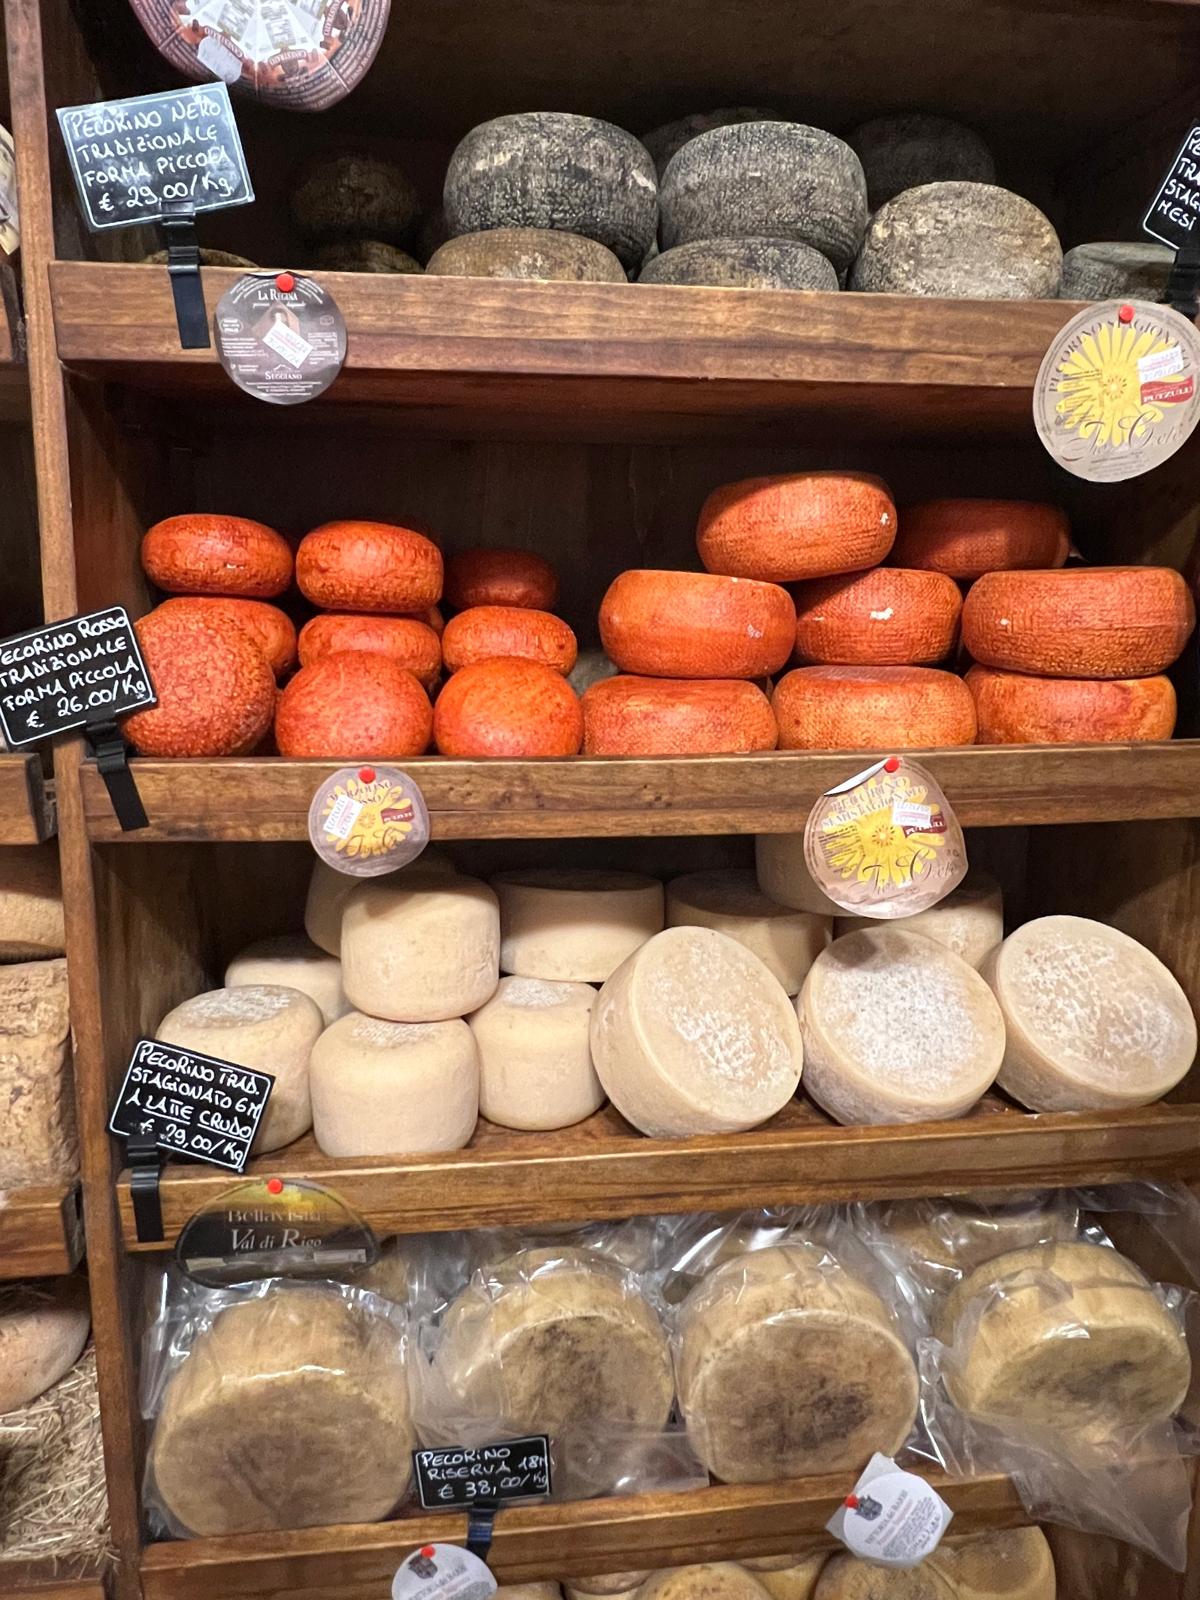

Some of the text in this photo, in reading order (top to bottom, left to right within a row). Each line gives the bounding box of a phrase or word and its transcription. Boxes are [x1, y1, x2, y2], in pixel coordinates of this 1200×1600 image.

[172, 100, 221, 122] NERO
[83, 162, 152, 187] FORMA
[98, 191, 115, 211] €
[1165, 179, 1200, 212] STAG
[0, 635, 77, 665] ECORINO
[3, 679, 67, 711] FORMA
[219, 1068, 260, 1095] TRAD.
[126, 1088, 252, 1138] A LATTE CRUDO
[231, 1228, 322, 1250] Val di Rigo
[438, 1483, 455, 1499] €
